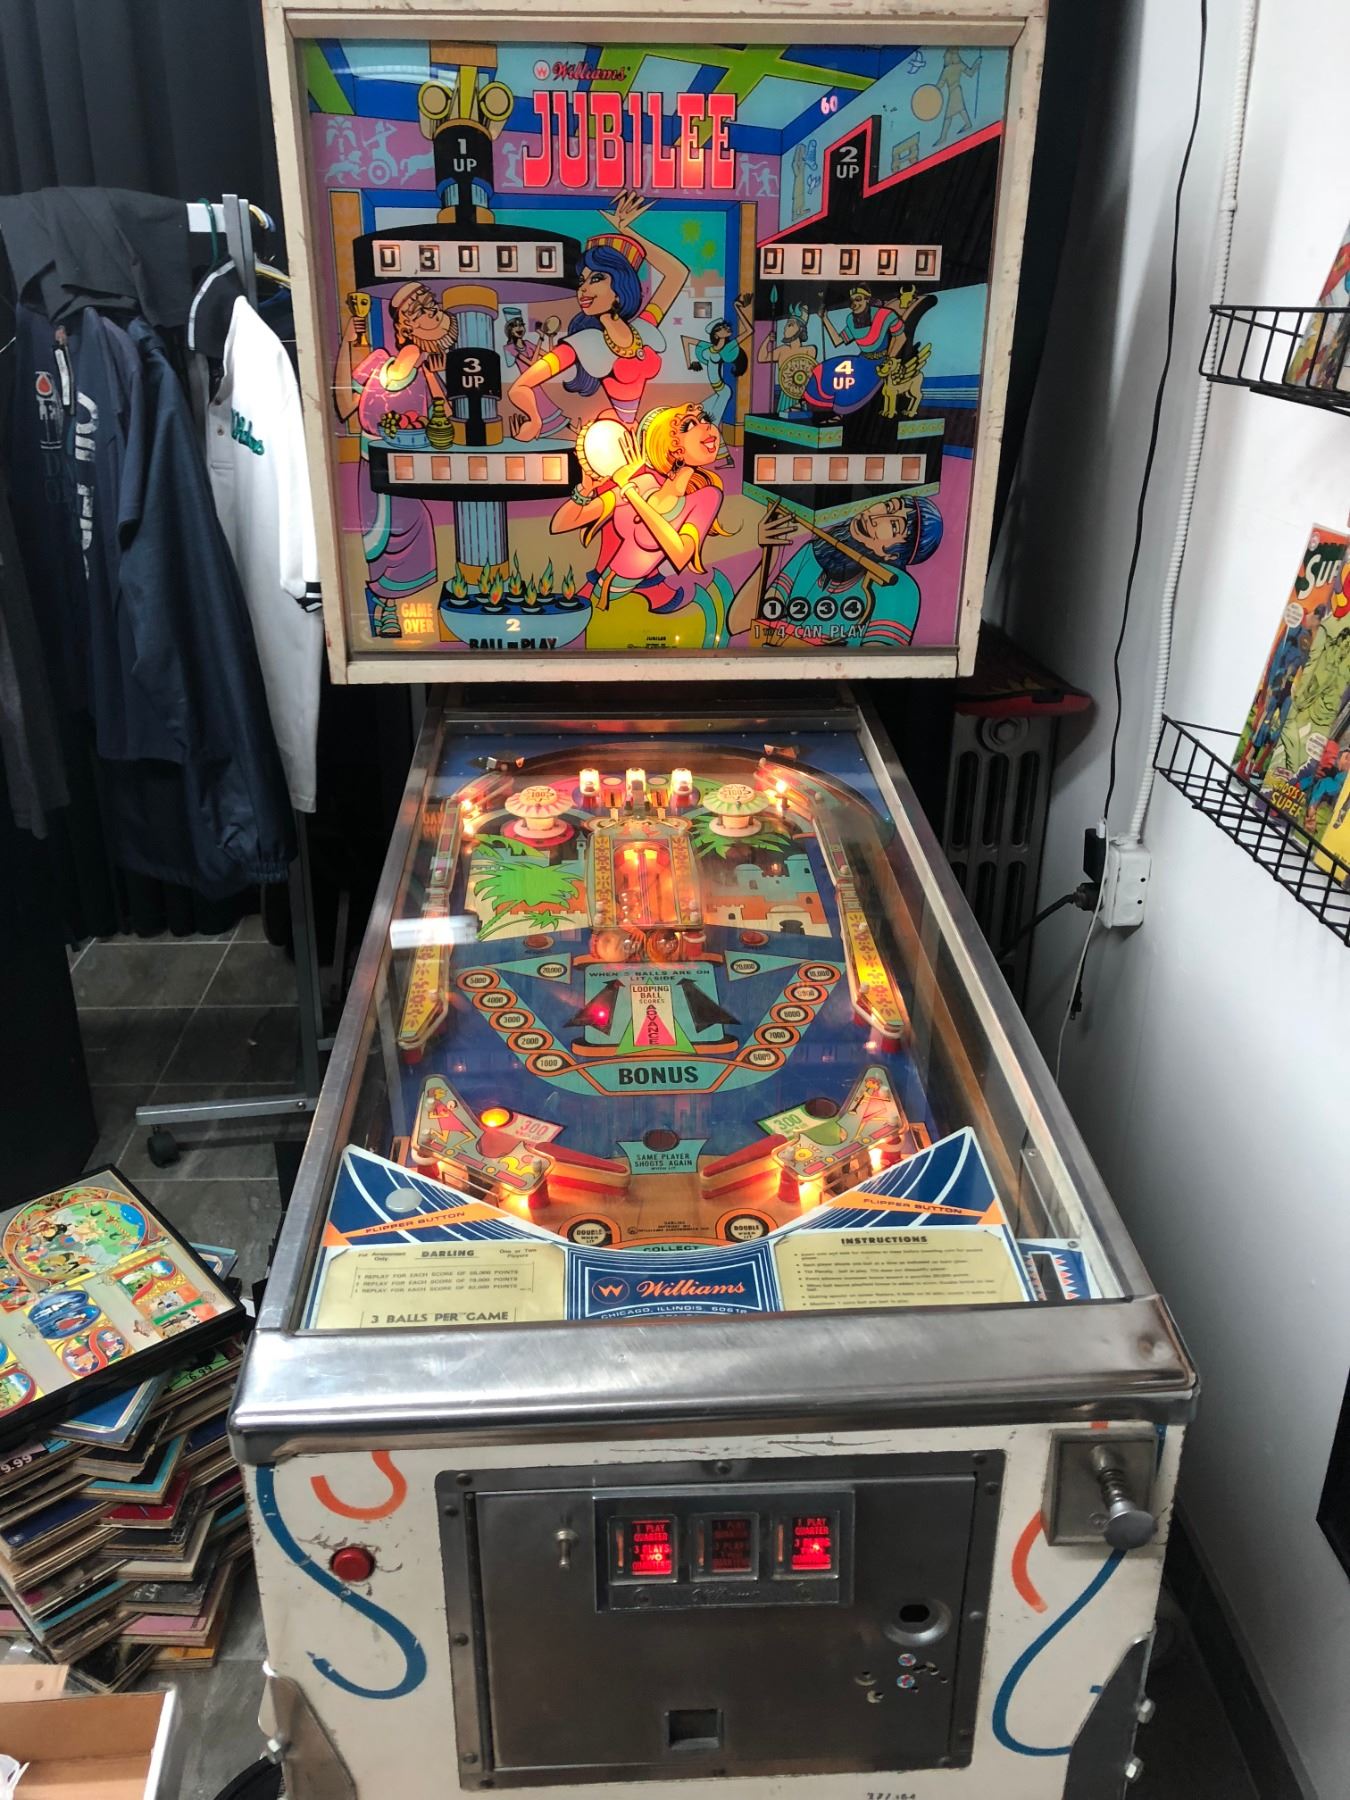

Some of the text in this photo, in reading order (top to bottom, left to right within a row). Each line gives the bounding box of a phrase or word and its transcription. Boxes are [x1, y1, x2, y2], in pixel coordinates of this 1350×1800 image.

[552, 61, 627, 82] Williams
[820, 95, 838, 115] 60
[457, 139, 466, 154] 1
[523, 90, 737, 189] JUBILEE
[839, 147, 858, 162] 2
[453, 158, 477, 172] UP
[836, 165, 860, 179] UP
[462, 358, 481, 373] 3
[835, 360, 854, 374] 4
[462, 376, 484, 389] UP
[833, 377, 855, 390] UP
[401, 603, 433, 617] GAME
[768, 602, 859, 615] 1 2 3 4
[403, 618, 434, 634] OVER
[506, 618, 520, 632] 2
[754, 625, 760, 639] 1
[777, 625, 786, 638] 4
[794, 625, 822, 639] CAN
[831, 624, 868, 638] PLAY
[521, 637, 557, 649] PLAY
[646, 1004, 660, 1045] ADVANCE
[618, 1065, 699, 1085] BONUS
[521, 1120, 549, 1136] 300
[774, 1114, 802, 1130] 300
[635, 1160, 664, 1168] SHOOTS
[863, 1198, 963, 1214] FLIPPER BUTTON
[366, 1211, 465, 1233] FLIPPER BUTTON
[841, 1236, 928, 1245] INSTRUCTIONS
[421, 1249, 475, 1258] DARLING
[643, 1244, 699, 1252] COLLECT
[636, 1280, 745, 1297] Williams
[371, 1311, 509, 1324] 3 BALLS PER GAME
[646, 1524, 665, 1532] PLAY
[642, 1543, 671, 1553] PLAYS
